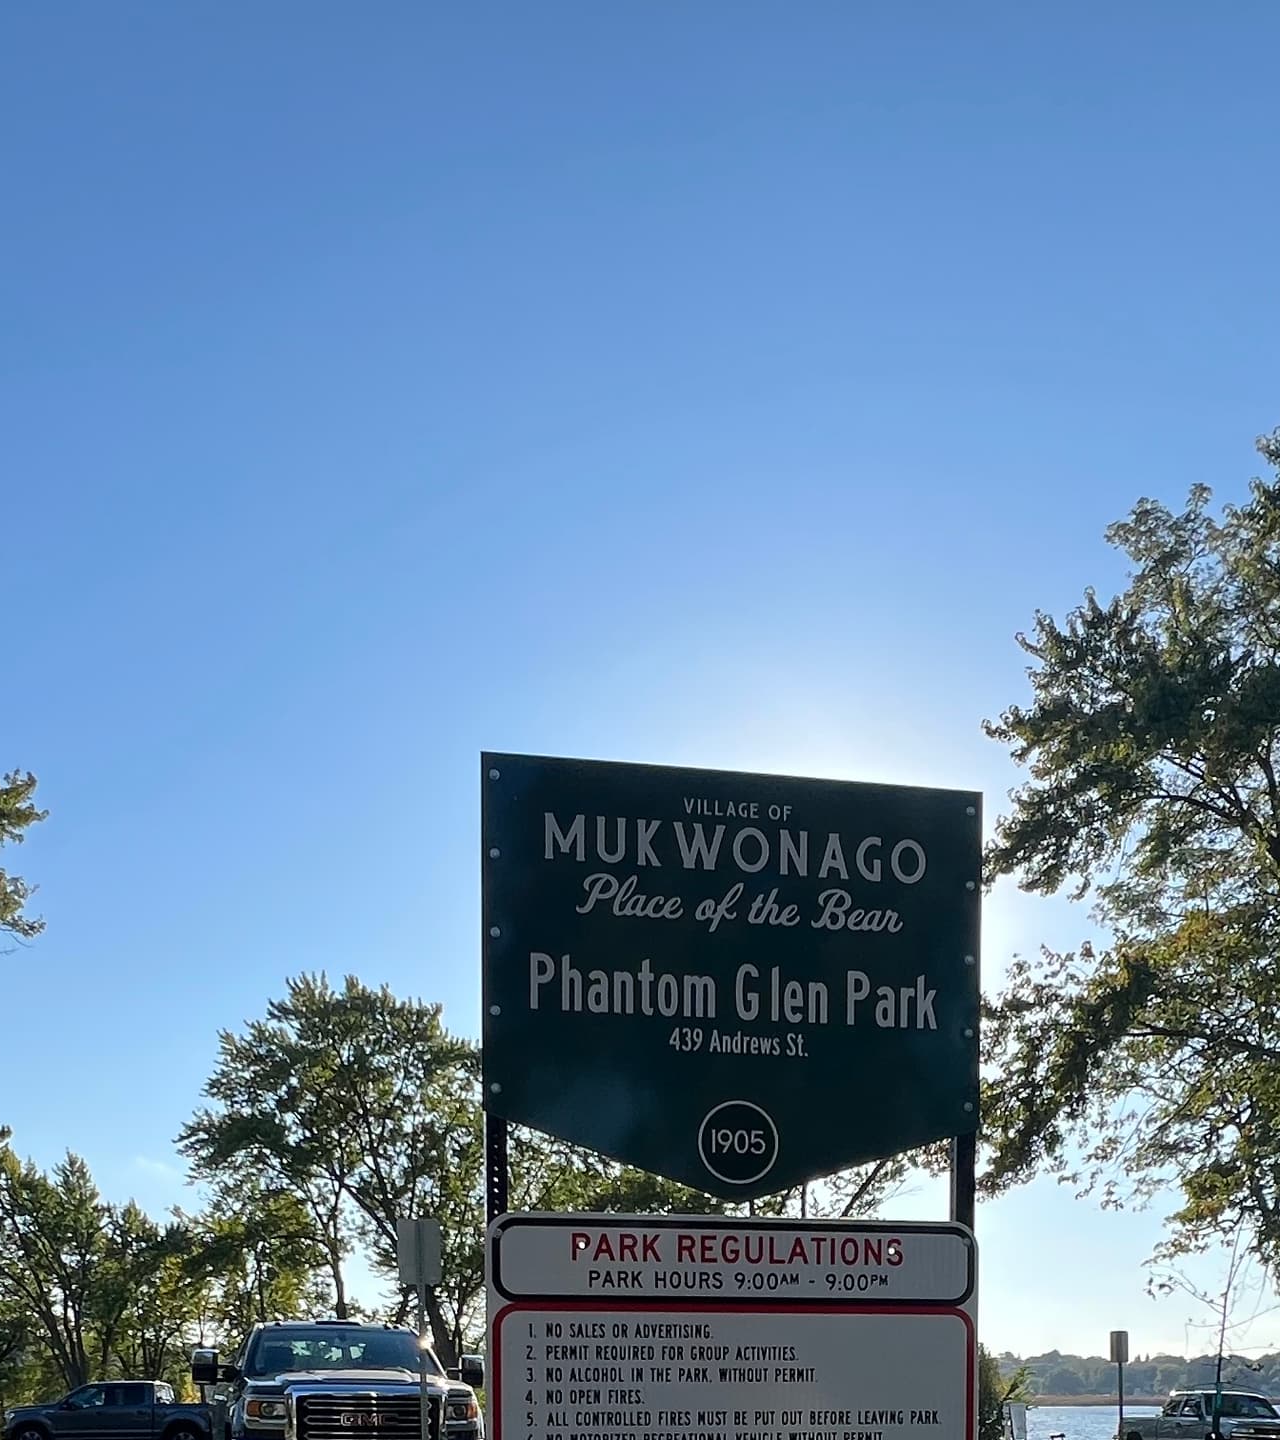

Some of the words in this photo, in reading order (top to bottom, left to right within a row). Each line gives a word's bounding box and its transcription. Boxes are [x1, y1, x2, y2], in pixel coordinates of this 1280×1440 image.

[684, 798, 759, 818] VILLAGE
[769, 805, 792, 821] OF
[544, 812, 927, 885] MUKWONAGO
[576, 873, 683, 919] Place
[695, 883, 744, 932] of
[748, 888, 800, 926] the
[811, 889, 903, 933] Bear
[530, 952, 715, 1018] Phantom
[736, 964, 827, 1023] Glen
[847, 971, 937, 1029] Park
[669, 1028, 702, 1051] 439
[710, 1030, 780, 1055] Andrews
[786, 1033, 809, 1056] St.
[712, 1129, 765, 1154] 1905
[572, 1233, 660, 1262] PARK
[678, 1235, 903, 1266] REGULATIONS
[589, 1270, 643, 1288] PARK
[655, 1271, 723, 1289] HOURS
[735, 1272, 799, 1290] 9:00AM
[826, 1274, 888, 1291] 9:00PM
[529, 1323, 536, 1338] 1.
[546, 1323, 562, 1338] NO
[570, 1323, 605, 1338] SALES
[613, 1324, 628, 1338] OR
[635, 1323, 713, 1339] ADVERTISING.
[526, 1345, 536, 1360] 2.
[546, 1345, 589, 1360] PERMIT
[596, 1345, 654, 1361] REQUIRED
[662, 1346, 683, 1360] FOR
[691, 1346, 729, 1360] GROUP
[735, 1346, 799, 1361] ACTIVITIES.
[526, 1368, 536, 1382] 3.
[546, 1368, 562, 1382] NO
[569, 1367, 624, 1382] ALCOHOL
[631, 1368, 643, 1382] IN
[650, 1368, 671, 1382] THE
[719, 1368, 768, 1382] WITHOUT
[775, 1368, 817, 1382] PERMIT.
[546, 1390, 562, 1404] NO
[570, 1389, 600, 1404] OPEN
[609, 1389, 644, 1404] FIRES.
[527, 1412, 537, 1427] 5.
[547, 1412, 568, 1426] ALL
[576, 1411, 651, 1426] CONTROLLED
[659, 1411, 690, 1426] FIRES
[698, 1411, 727, 1426] MUST
[734, 1411, 748, 1425] BE
[755, 1411, 775, 1425] PUT
[782, 1411, 802, 1425] OUT
[810, 1411, 851, 1425] BEFORE
[858, 1410, 903, 1424] LEAVING
[911, 1411, 941, 1424] PARK.
